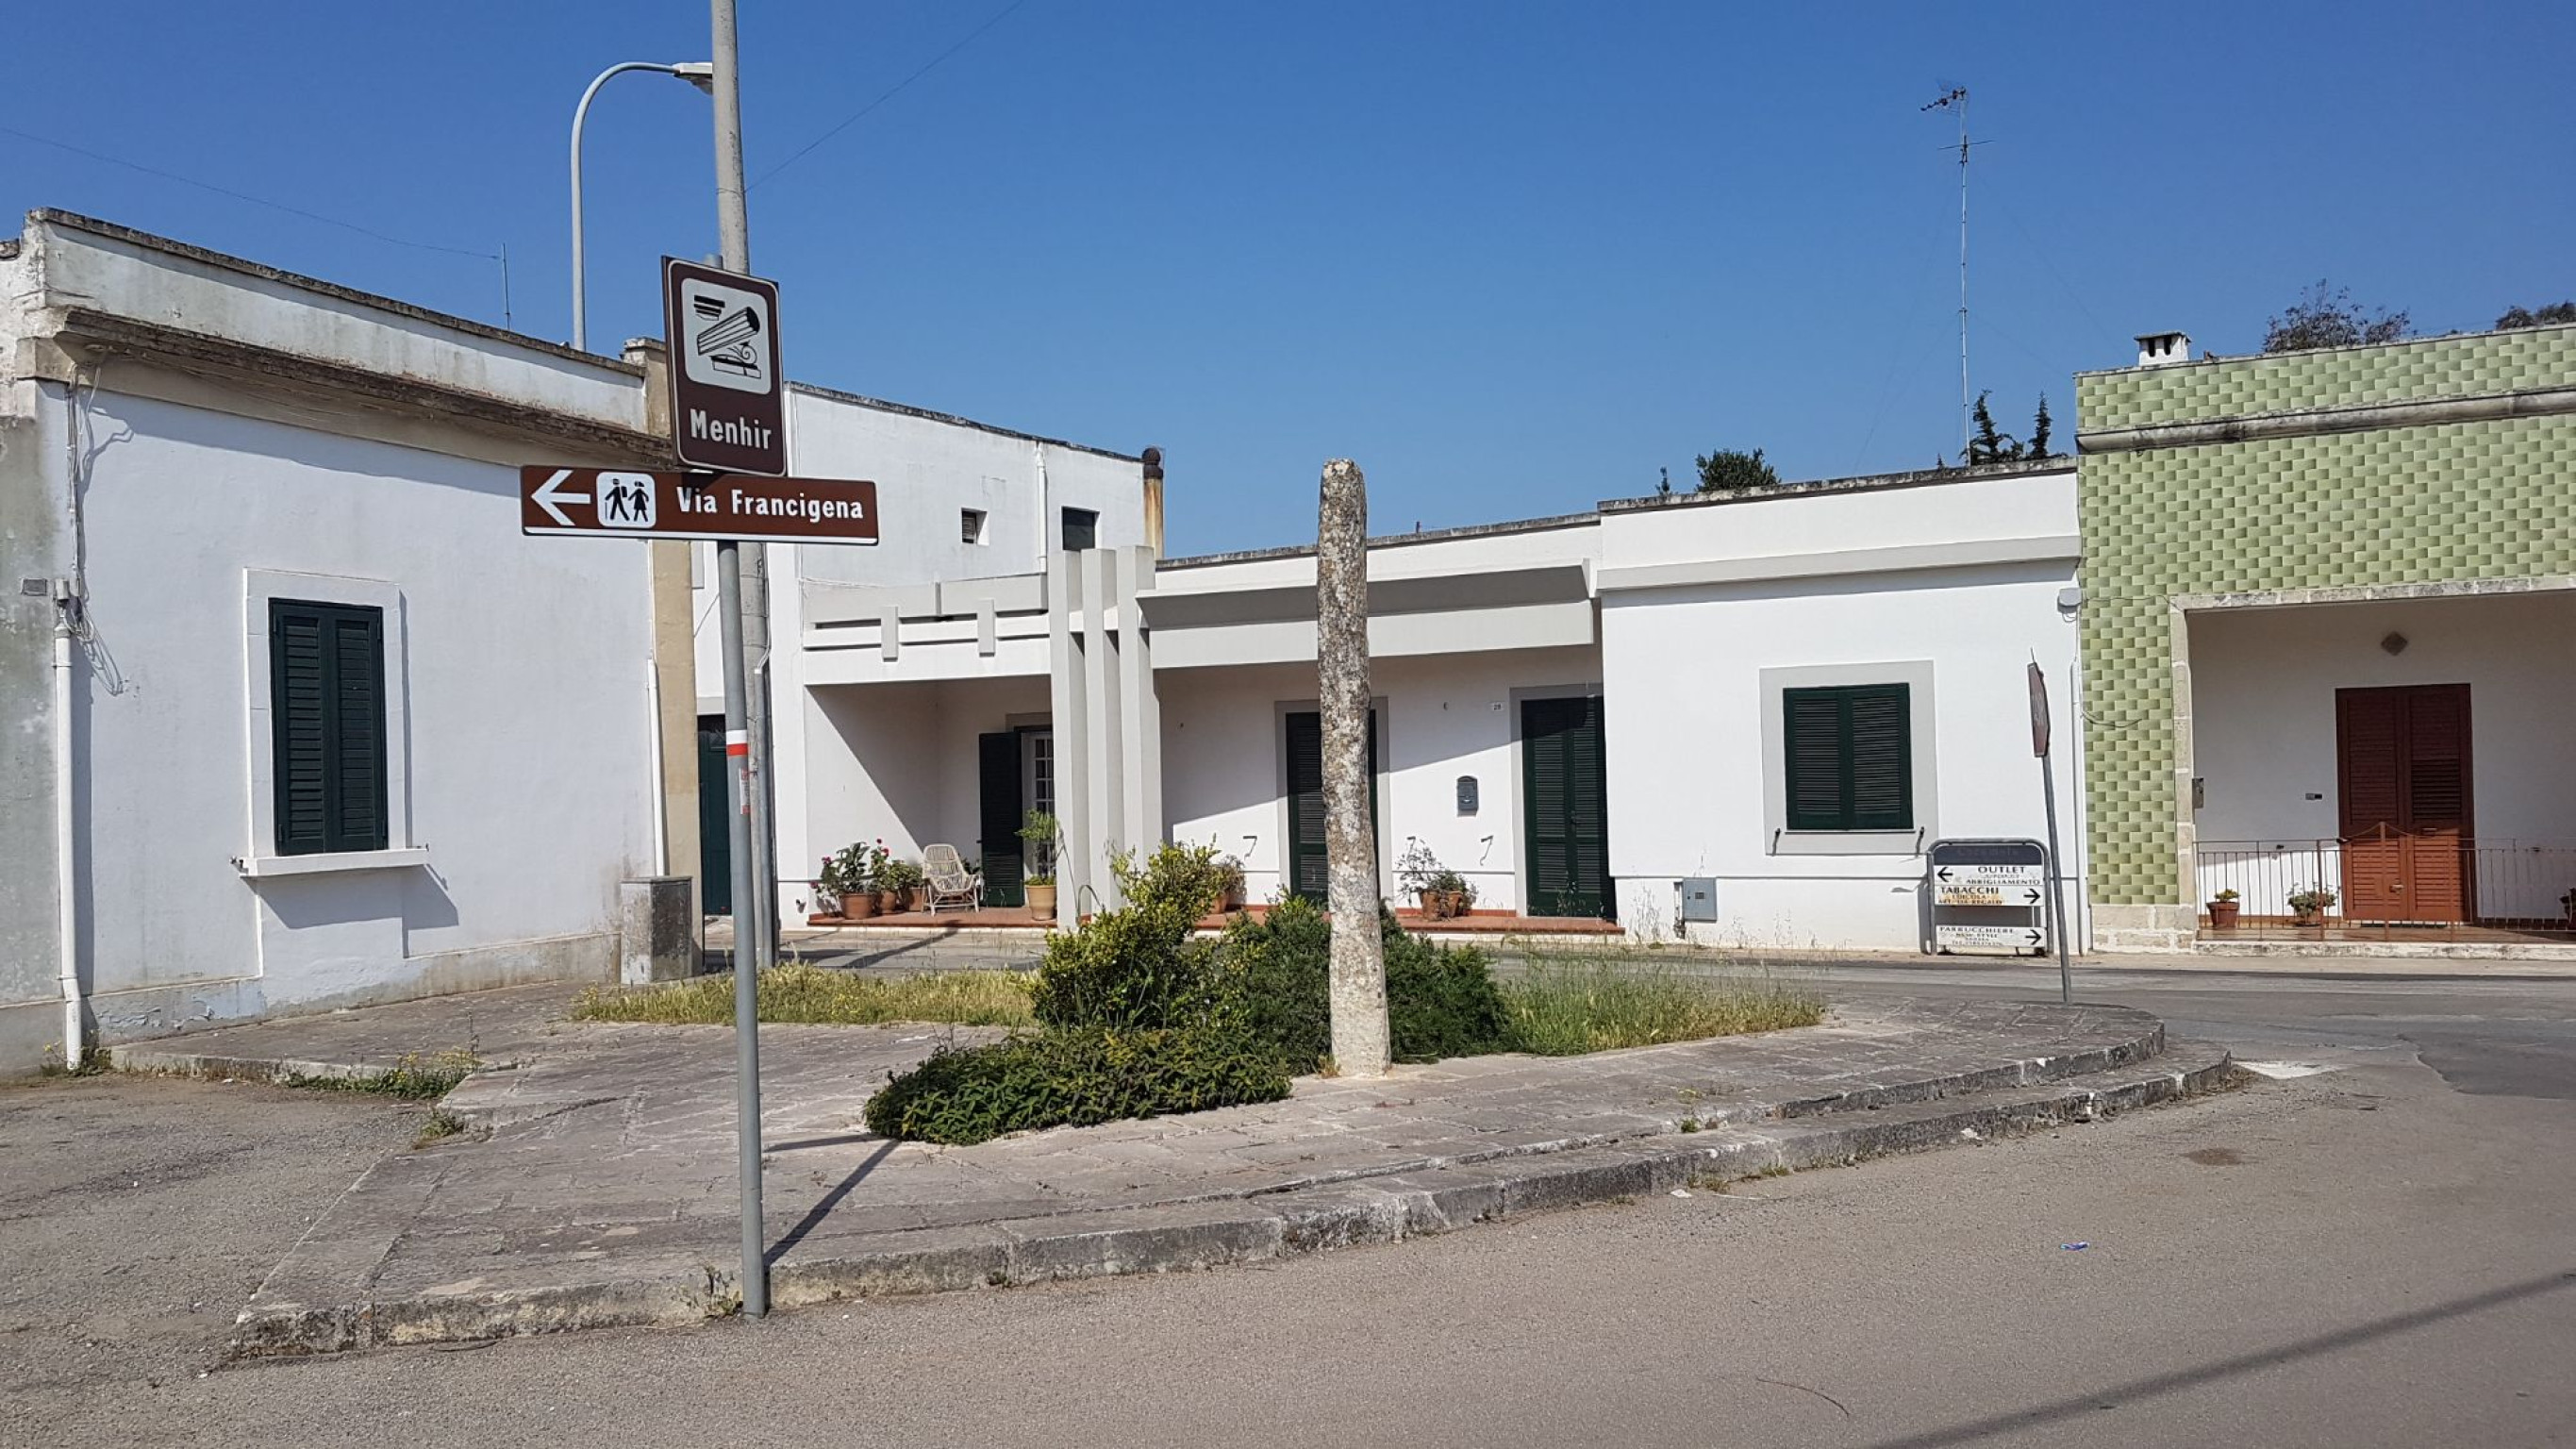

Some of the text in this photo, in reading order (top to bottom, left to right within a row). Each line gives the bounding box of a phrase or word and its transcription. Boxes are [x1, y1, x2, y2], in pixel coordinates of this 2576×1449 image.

[690, 408, 772, 450] Menhir
[676, 486, 864, 525] Via Francigena
